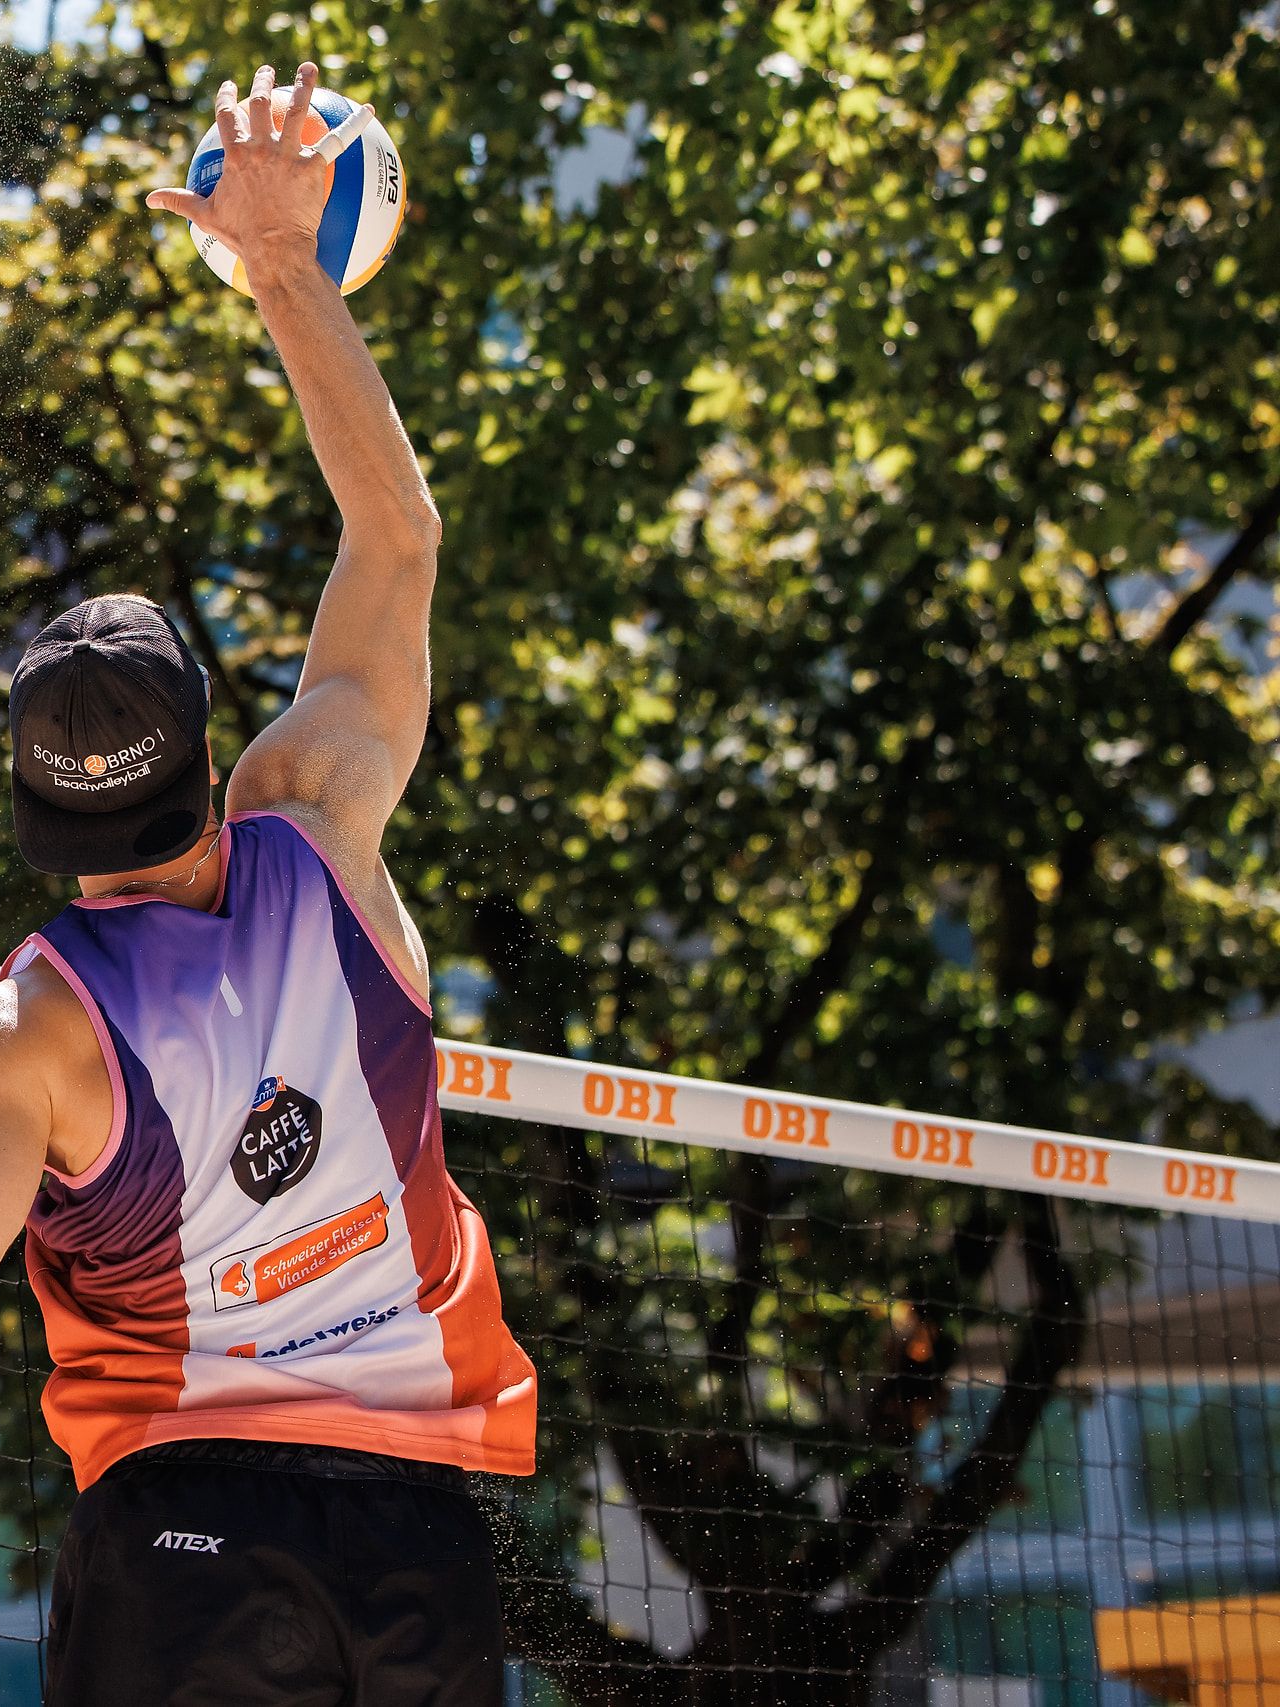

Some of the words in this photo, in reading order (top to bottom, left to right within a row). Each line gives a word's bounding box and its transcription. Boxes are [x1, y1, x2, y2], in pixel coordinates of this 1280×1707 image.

[33, 744, 84, 774] SOKOL
[106, 736, 156, 769] BRNO
[54, 764, 151, 792] beachvolleyball
[583, 1073, 677, 1125] OBI
[743, 1097, 831, 1148] OBI
[241, 1102, 307, 1155] CAFFÈ
[249, 1124, 313, 1182] LATTE
[893, 1120, 974, 1169] OBI
[1032, 1141, 1110, 1187] OBI
[1165, 1159, 1237, 1203] OBI
[261, 1236, 330, 1280] Schweizer
[331, 1210, 383, 1245] Fleisch
[276, 1255, 326, 1290] Viande
[328, 1230, 372, 1260] Suisse
[153, 1531, 225, 1554] ATEX
